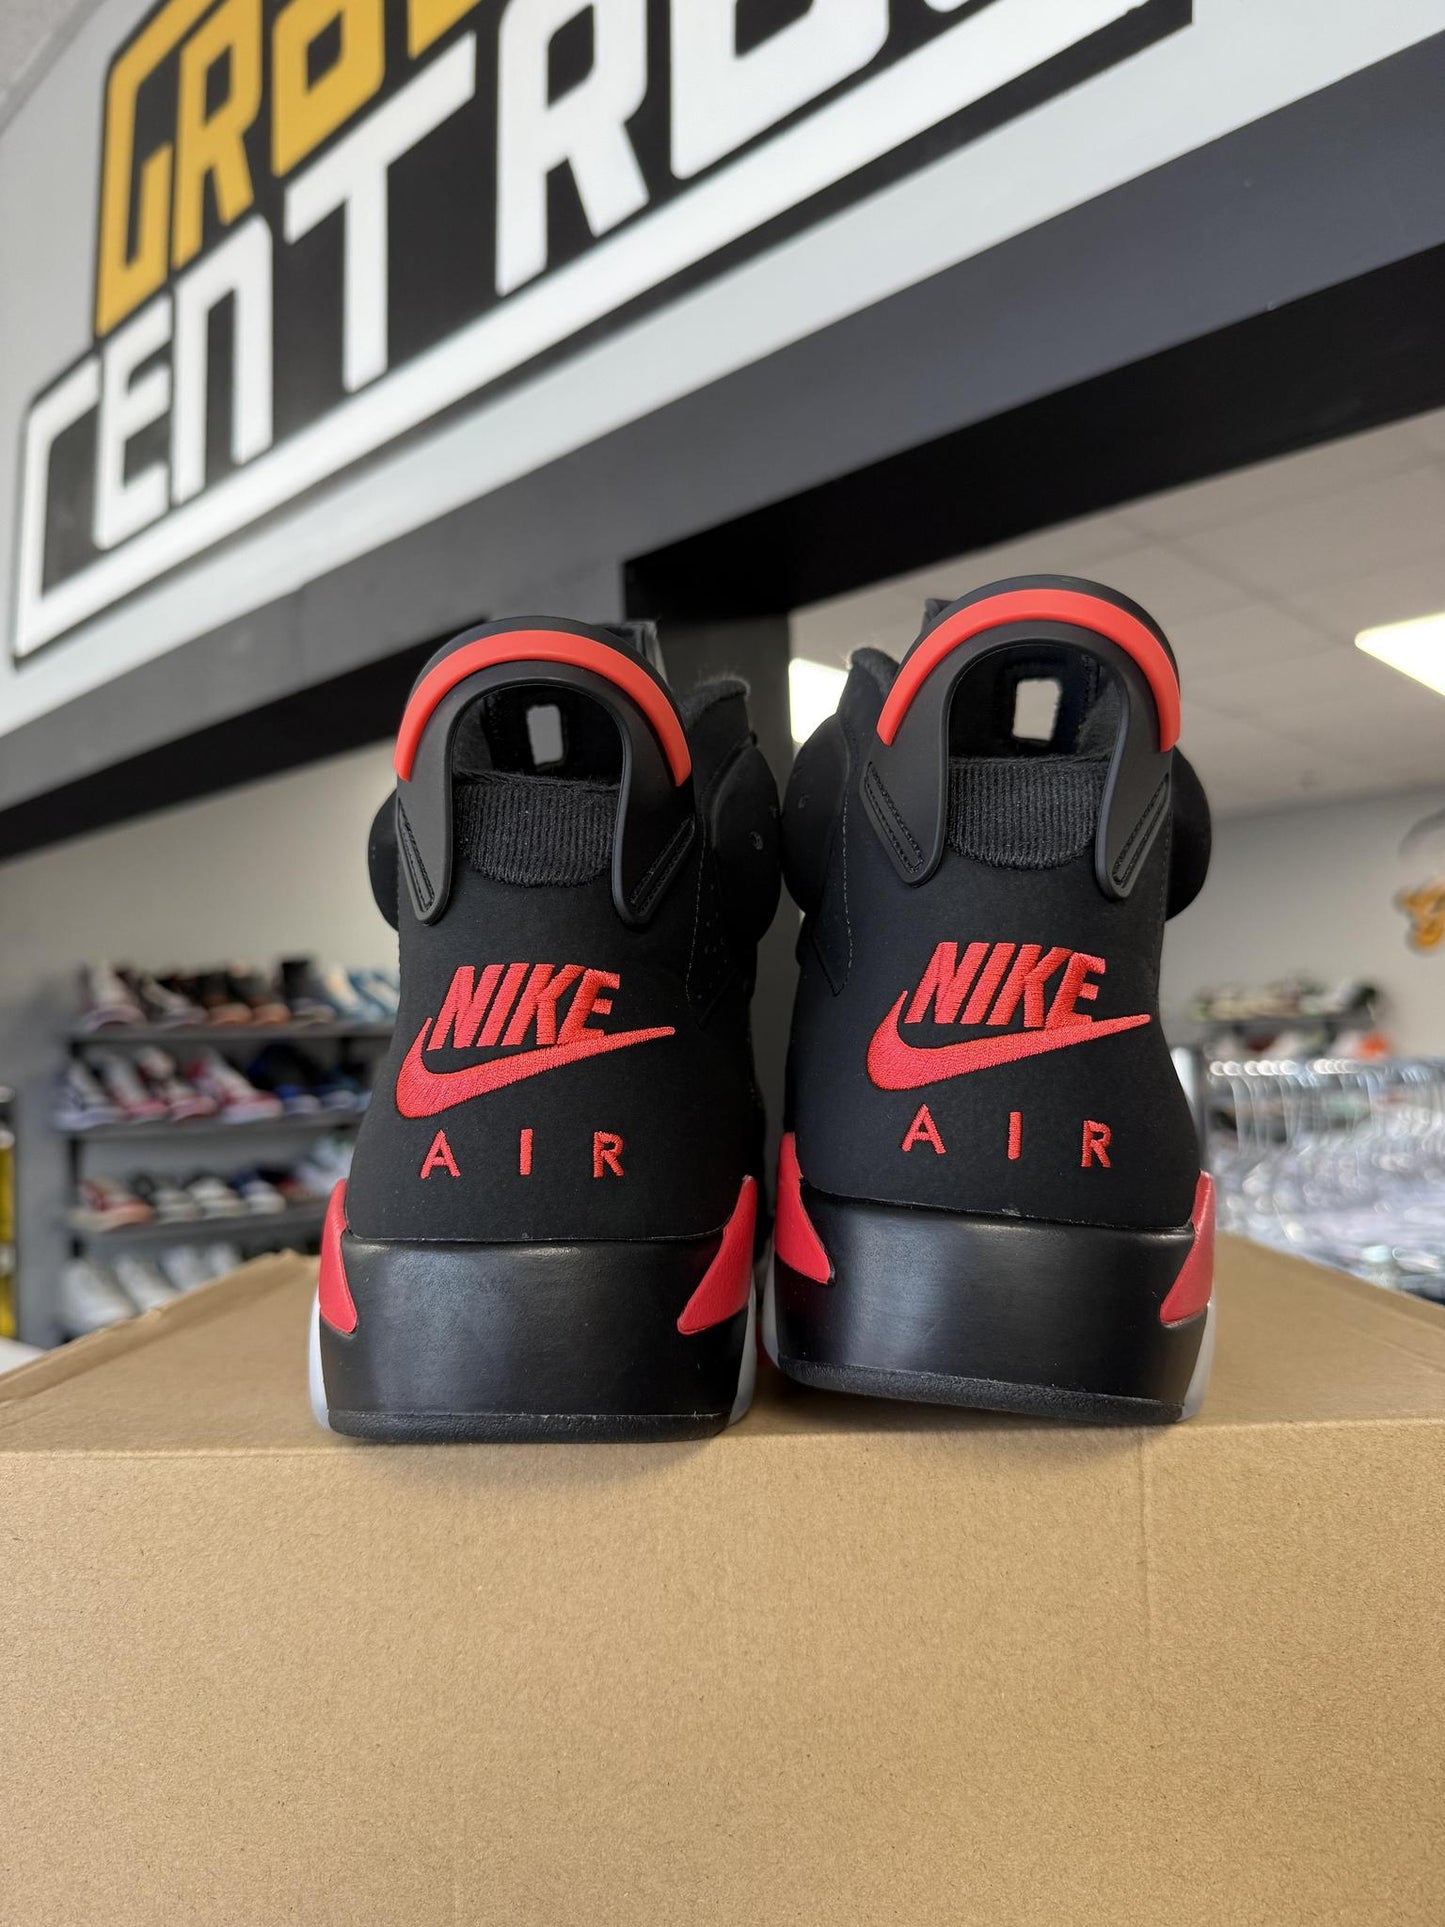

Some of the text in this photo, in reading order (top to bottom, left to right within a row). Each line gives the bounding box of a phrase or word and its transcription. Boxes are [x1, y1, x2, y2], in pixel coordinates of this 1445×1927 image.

[426, 962, 620, 1051] NIKE
[904, 941, 1106, 1030] NIKE
[418, 1128, 625, 1179] AIR
[901, 1103, 1112, 1169] AIR
